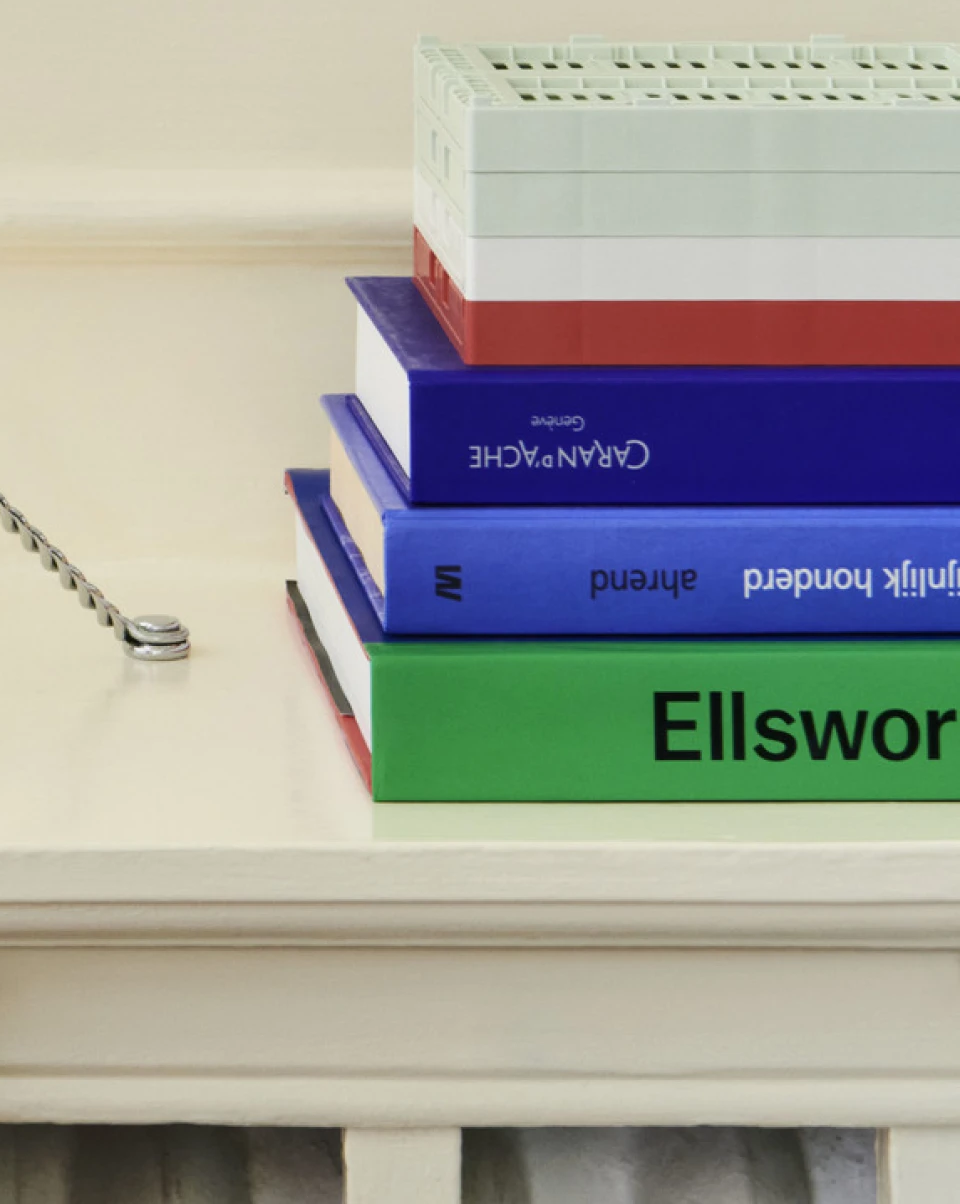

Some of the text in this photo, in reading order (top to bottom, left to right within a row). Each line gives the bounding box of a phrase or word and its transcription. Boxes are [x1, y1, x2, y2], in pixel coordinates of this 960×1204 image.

[531, 415, 585, 432] Genève
[557, 439, 651, 471] CARAN
[590, 568, 698, 599] ahrend
[743, 567, 873, 598] honderd
[652, 690, 958, 762] Ellswor
